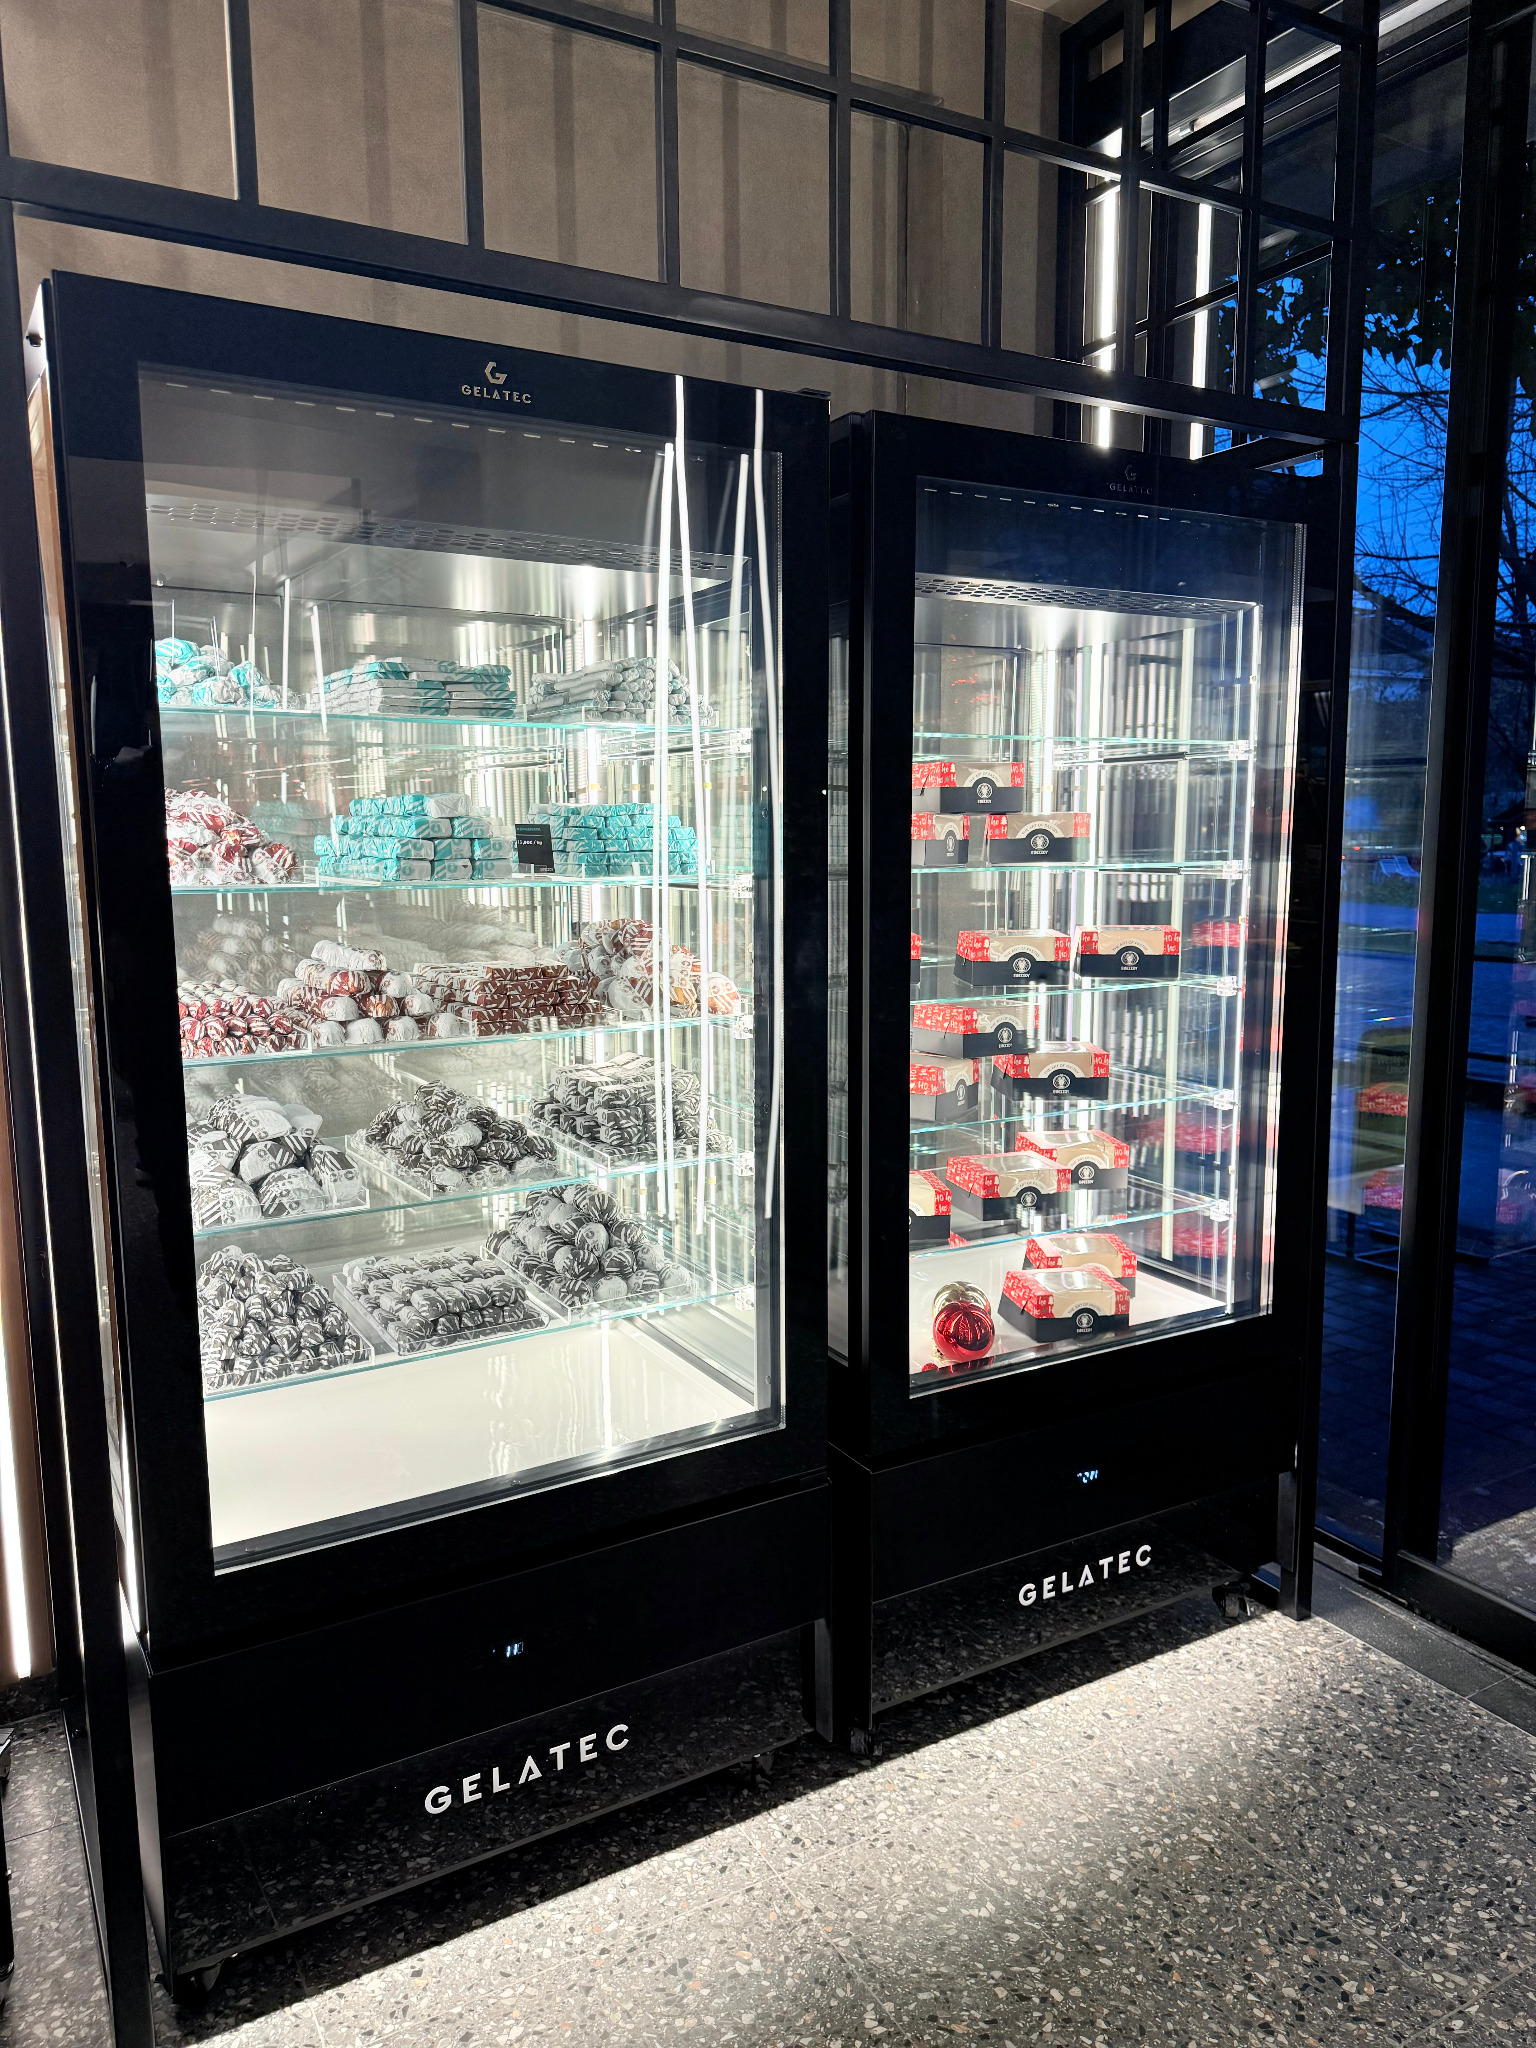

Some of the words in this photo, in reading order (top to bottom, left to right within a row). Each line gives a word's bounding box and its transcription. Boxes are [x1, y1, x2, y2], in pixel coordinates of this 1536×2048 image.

[461, 384, 532, 404] GELATEC
[1018, 1544, 1152, 1607] GELATEC
[424, 1723, 630, 1815] GELATEC
